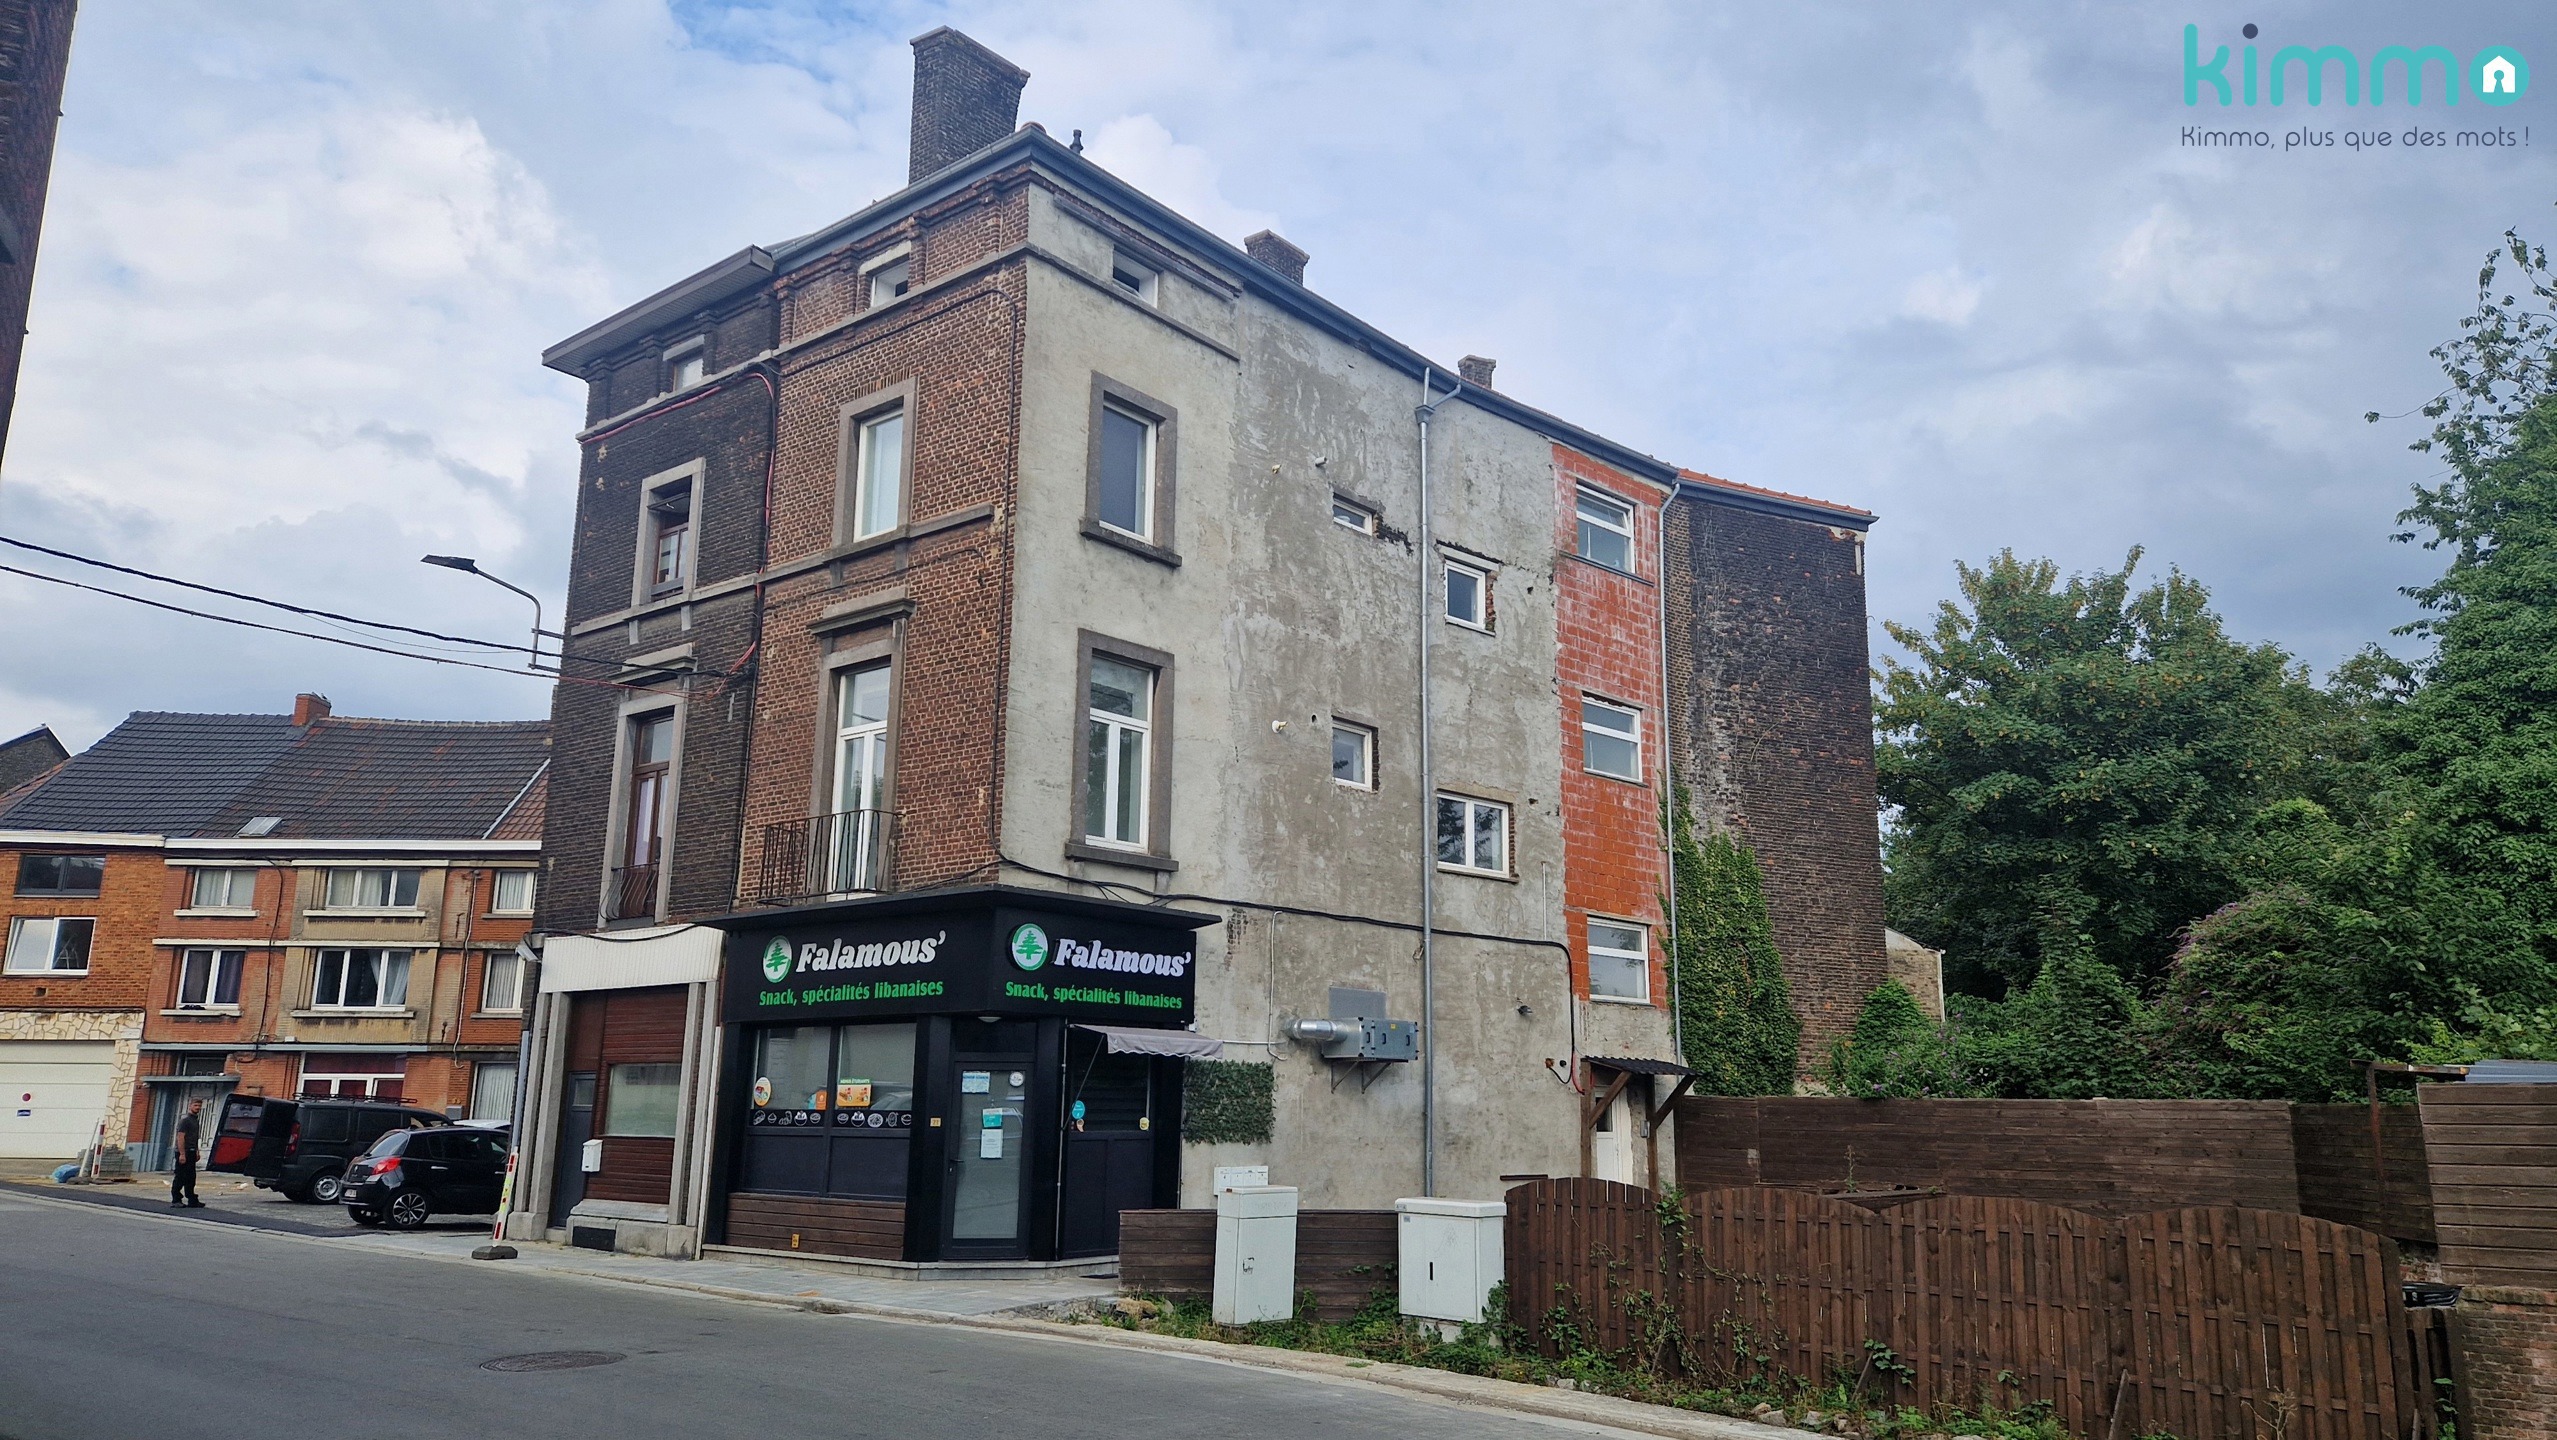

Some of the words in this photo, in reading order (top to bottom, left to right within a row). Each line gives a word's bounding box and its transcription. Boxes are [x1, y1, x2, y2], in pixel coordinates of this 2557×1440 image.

[795, 931, 947, 973] Falamous'
[1053, 938, 1192, 977] Falamous'
[759, 989, 797, 1007] Snack,
[801, 984, 870, 1006] spécialités
[874, 979, 944, 999] libanaises
[1005, 981, 1049, 1001] Snack,
[1053, 986, 1121, 1005] spécialités
[1123, 991, 1183, 1009] libanaises
